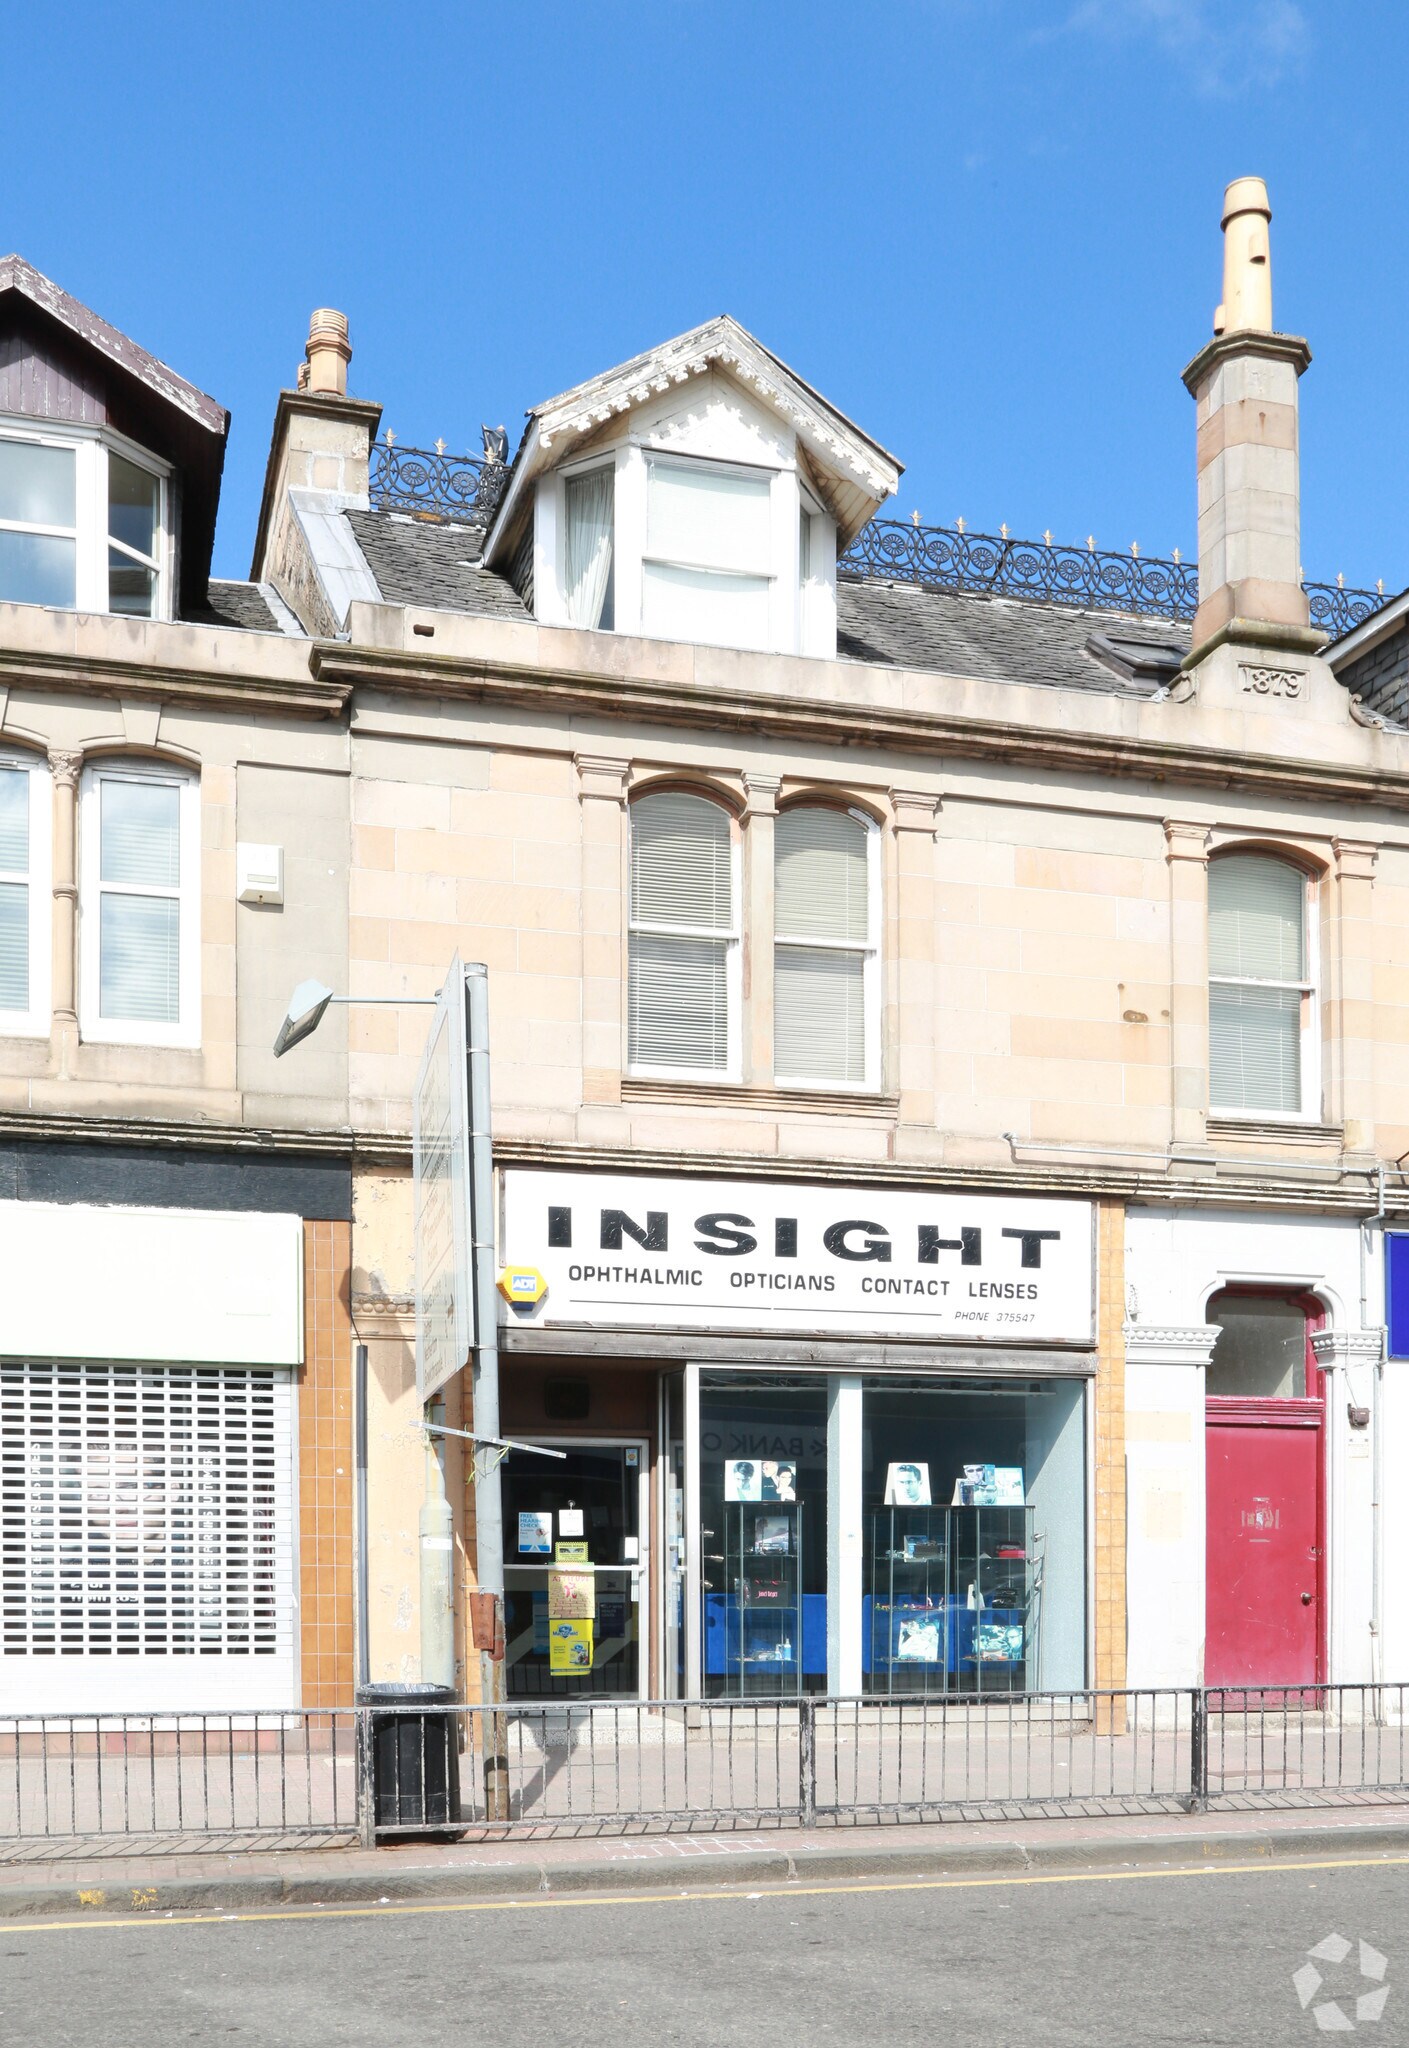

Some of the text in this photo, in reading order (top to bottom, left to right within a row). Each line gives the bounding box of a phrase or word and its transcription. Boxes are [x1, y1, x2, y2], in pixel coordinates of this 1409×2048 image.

[1241, 667, 1303, 699] 1879
[548, 1206, 1061, 1269] INSIGHT
[513, 1278, 536, 1291] ADT
[568, 1265, 1038, 1300] OPHTHALMIC OPTICIANS CONTACT LENSES
[954, 1311, 1036, 1323] PHONE 375547
